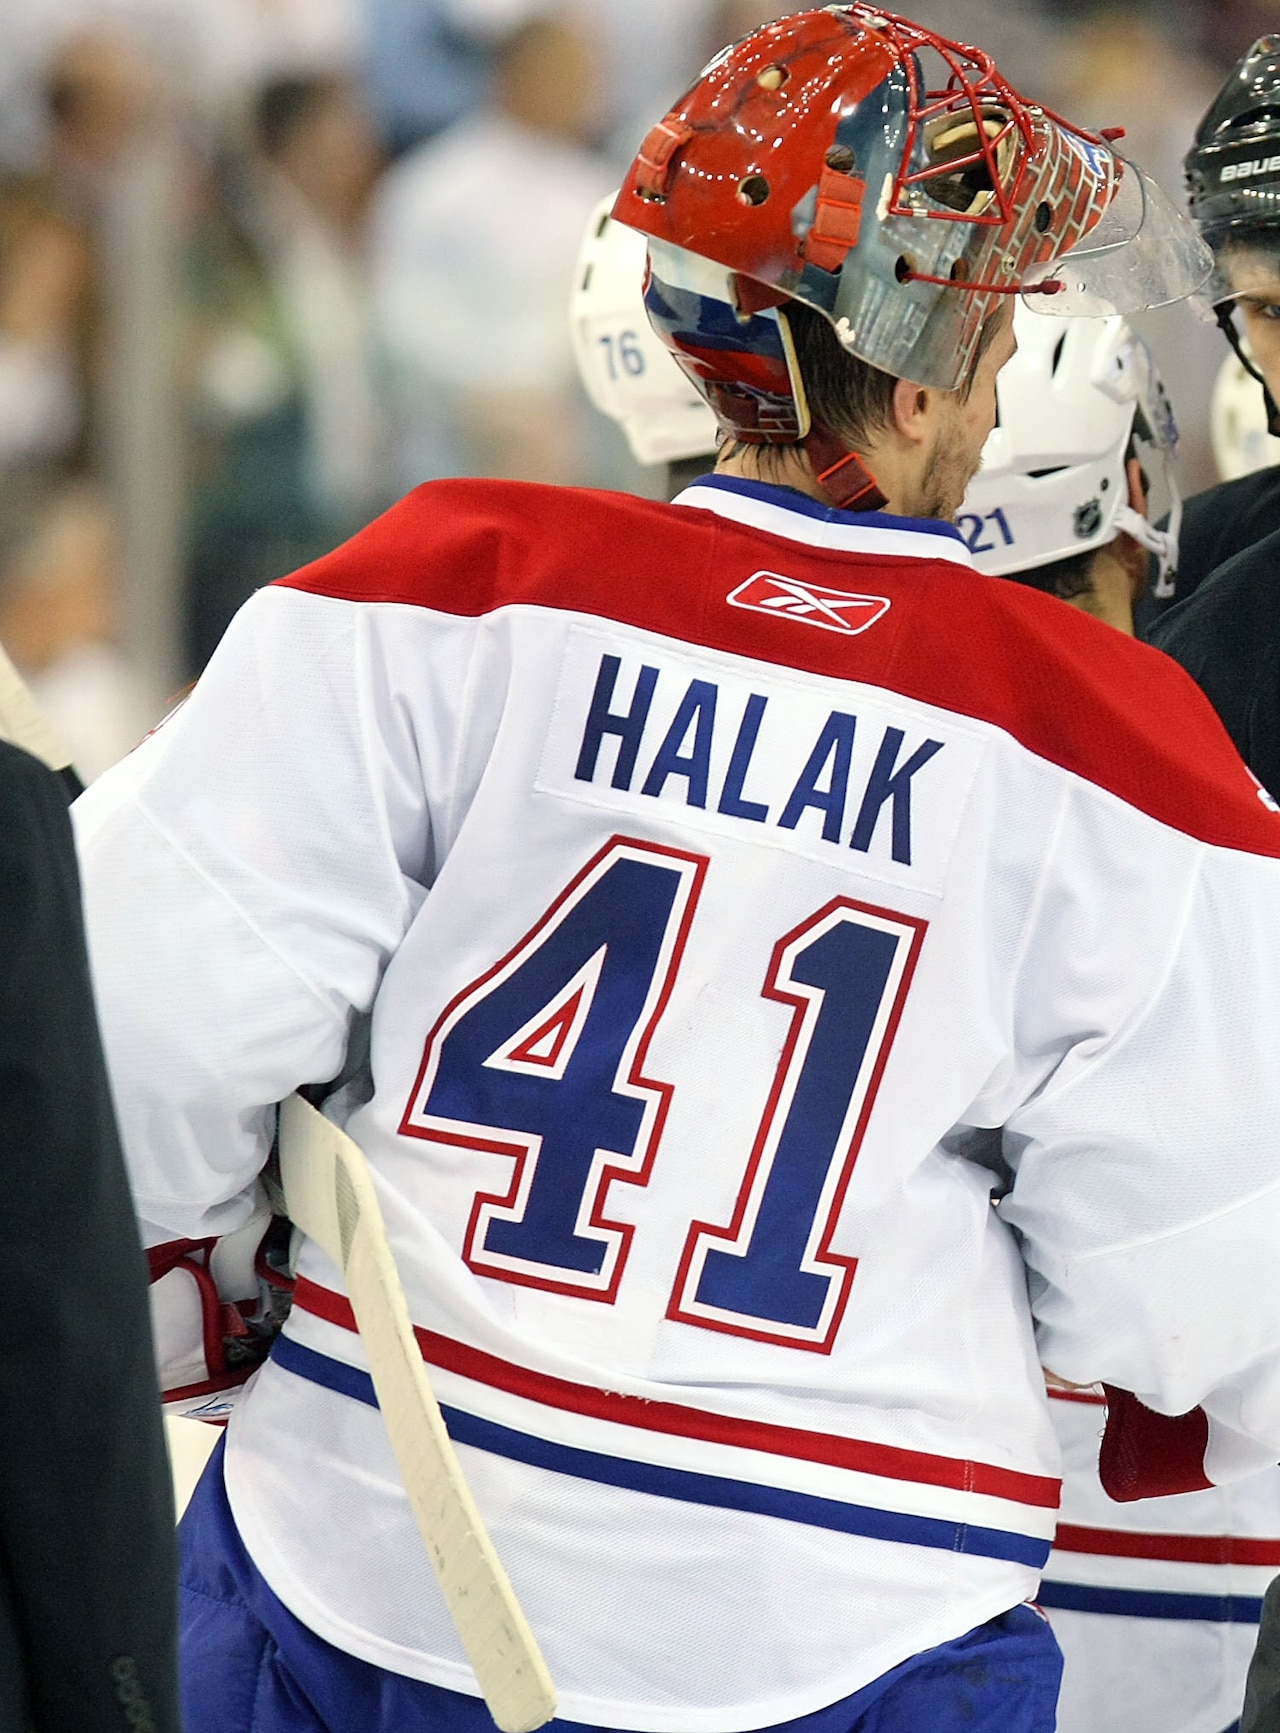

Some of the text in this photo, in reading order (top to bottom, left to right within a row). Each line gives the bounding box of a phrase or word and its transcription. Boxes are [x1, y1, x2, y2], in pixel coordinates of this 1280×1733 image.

[599, 330, 645, 381] 76
[955, 506, 1014, 554] 21
[574, 653, 945, 867] HALAK
[397, 833, 930, 1356] 41
